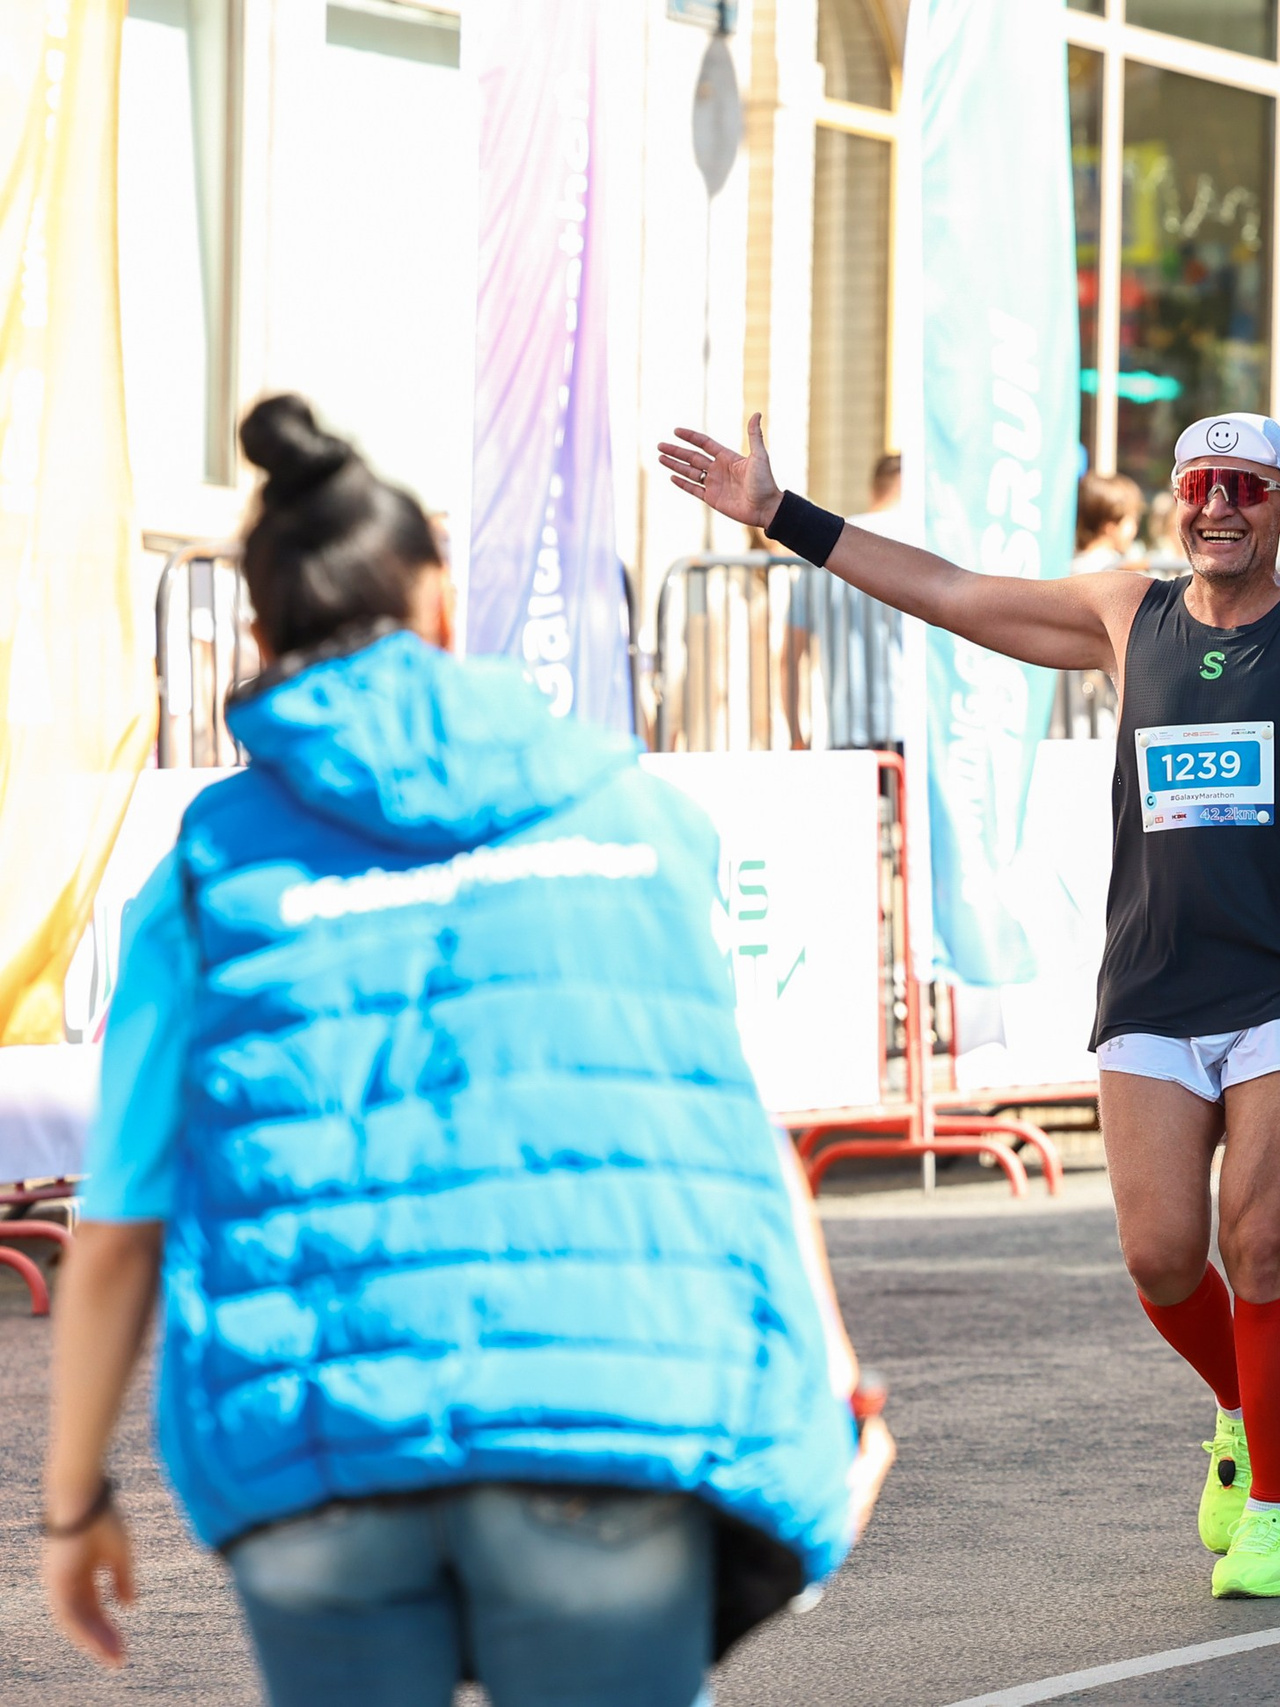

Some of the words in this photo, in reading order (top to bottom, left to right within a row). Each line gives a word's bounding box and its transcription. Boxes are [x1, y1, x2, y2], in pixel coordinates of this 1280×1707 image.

[1200, 651, 1225, 680] S
[1161, 750, 1241, 782] 1239
[1170, 792, 1235, 802] #GalaxyMarathon
[1200, 807, 1258, 823] 42,2km
